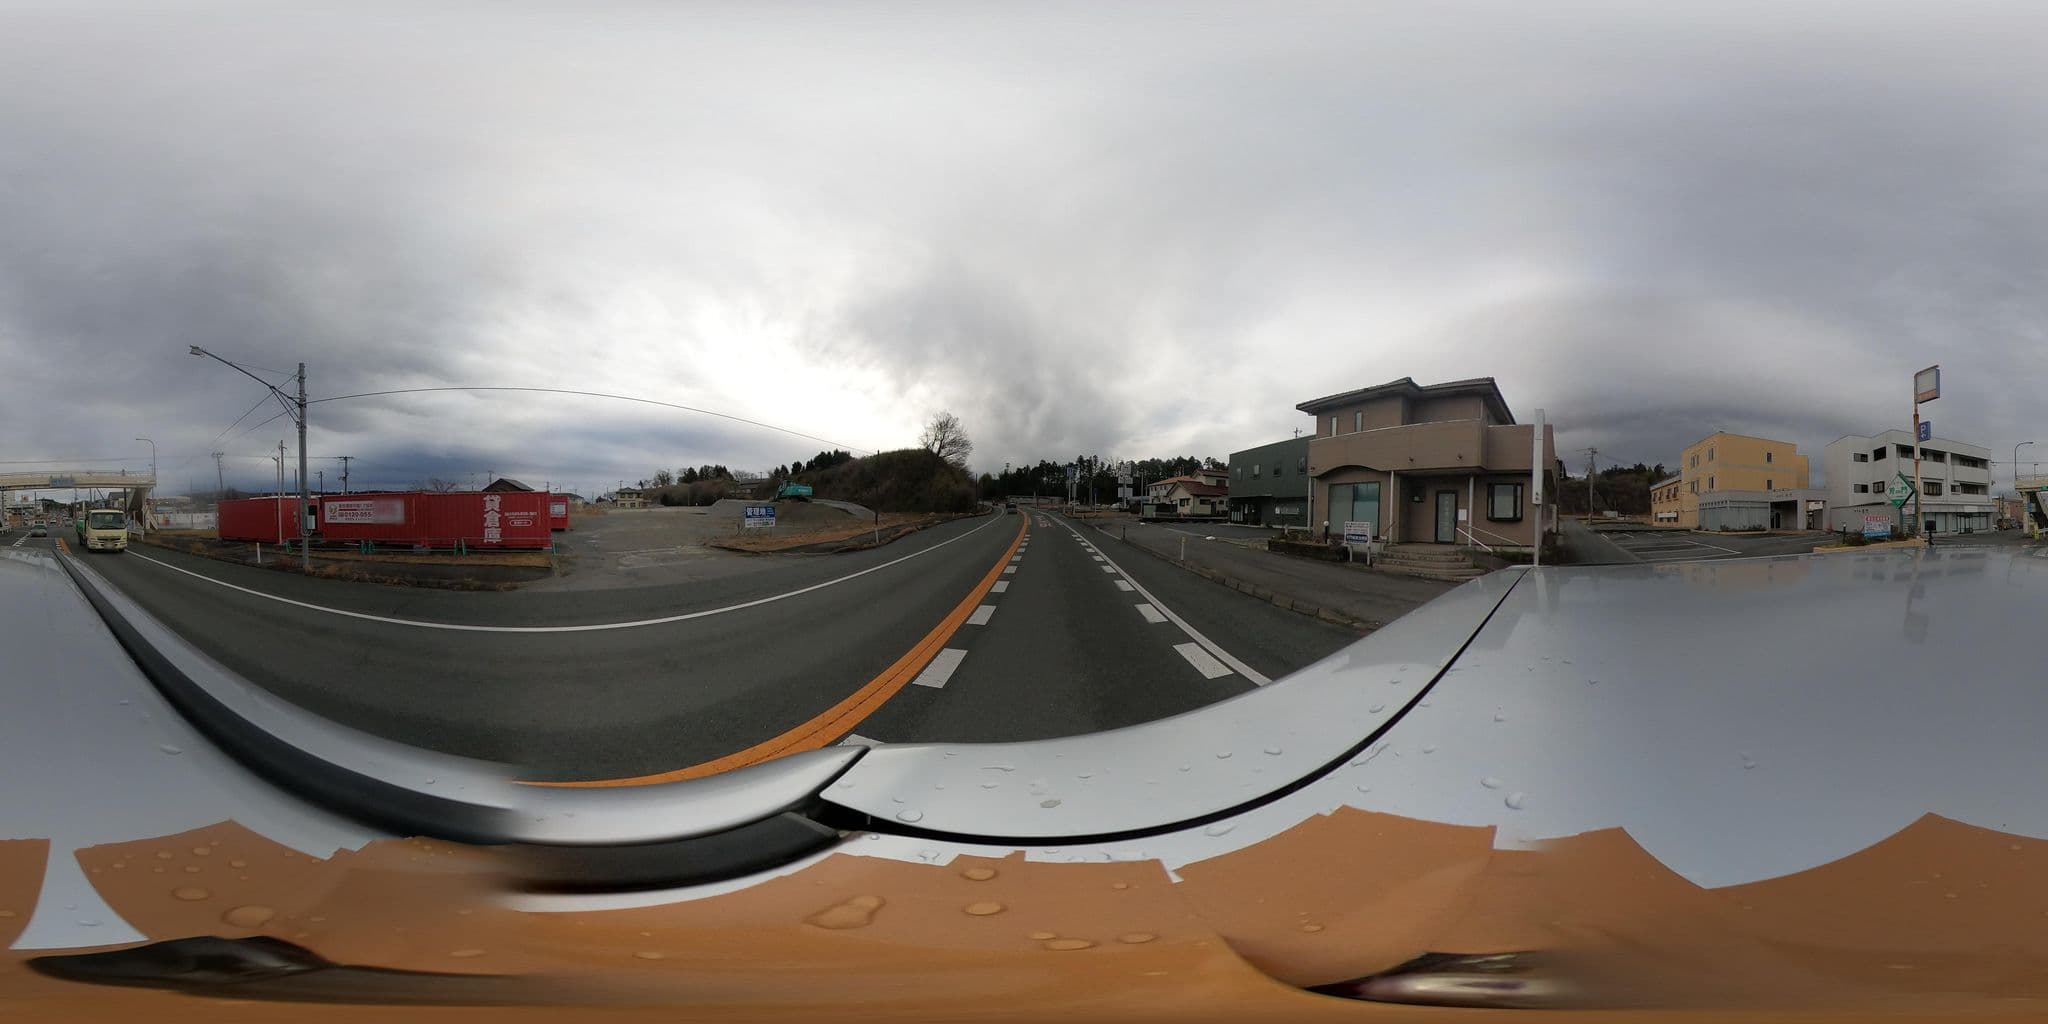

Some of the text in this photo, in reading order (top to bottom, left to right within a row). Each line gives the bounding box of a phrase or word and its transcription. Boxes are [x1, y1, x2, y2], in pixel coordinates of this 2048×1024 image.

[1920, 424, 1926, 434] P
[483, 494, 502, 544] 貸倉庫
